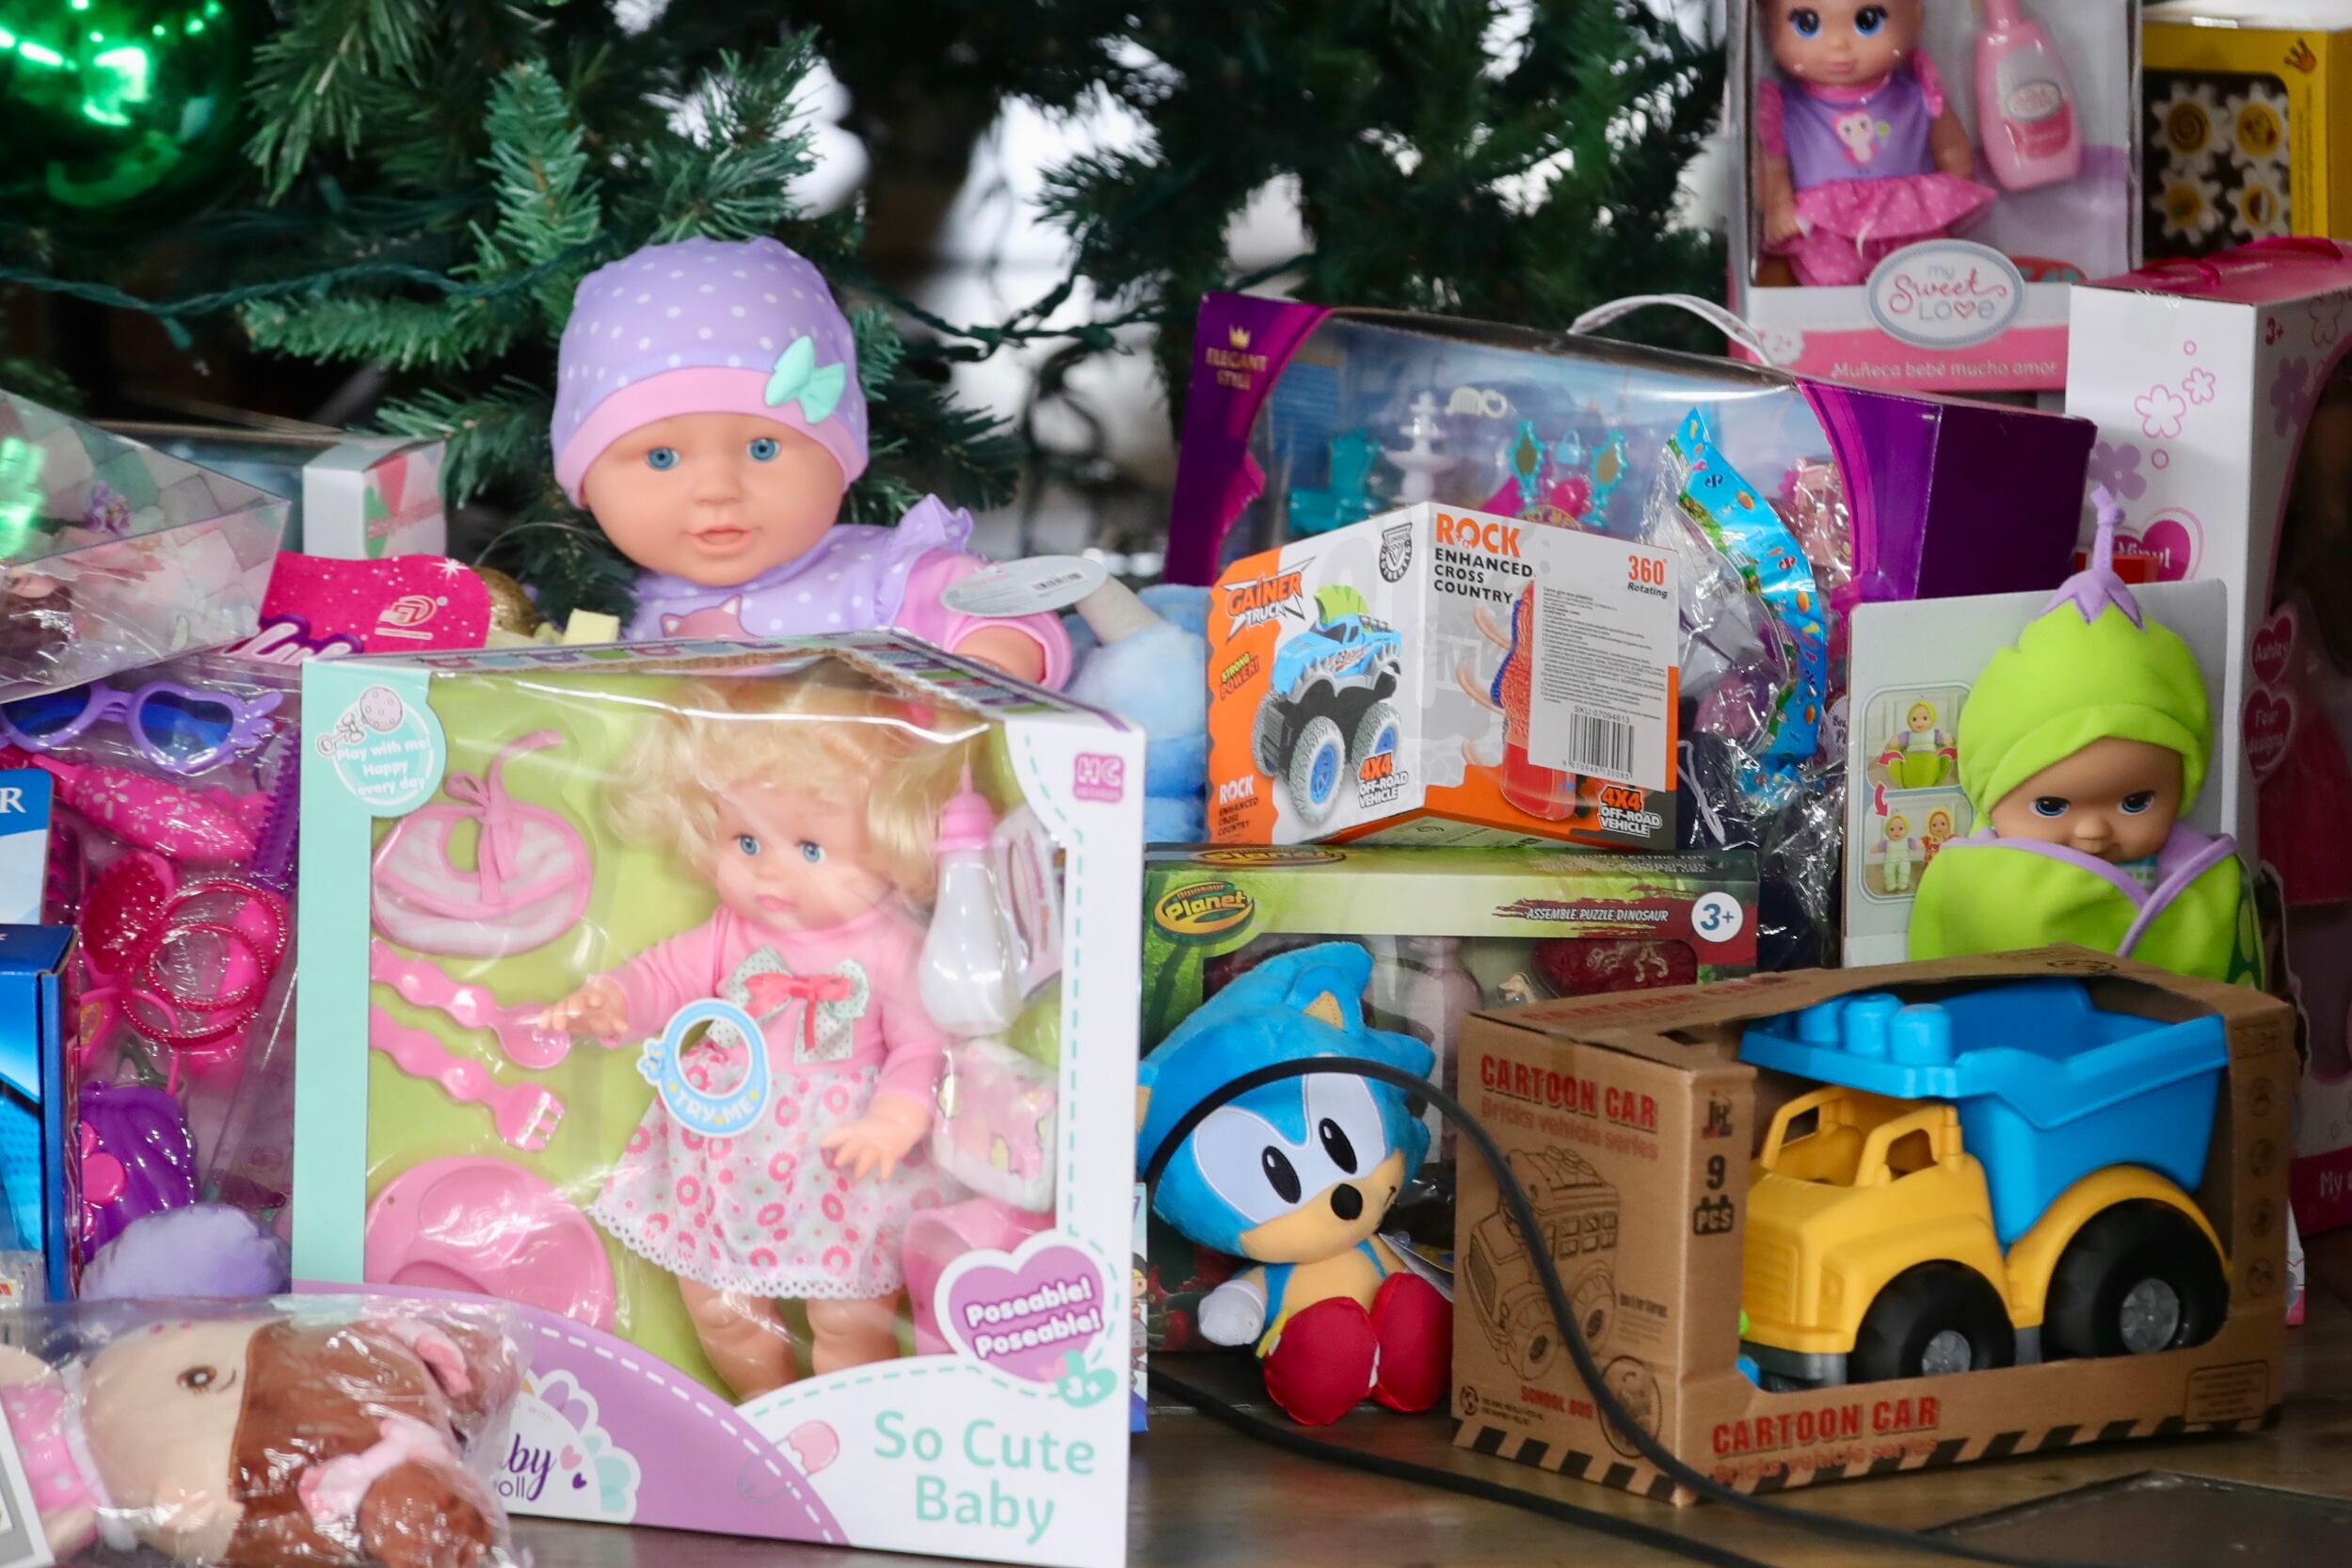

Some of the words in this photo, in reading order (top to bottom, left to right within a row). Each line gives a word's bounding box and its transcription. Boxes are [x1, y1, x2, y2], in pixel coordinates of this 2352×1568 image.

[1889, 267, 2008, 314] Sweet
[2265, 316, 2283, 346] 3+
[1832, 360, 1901, 378] Muñeca
[1905, 359, 1945, 377] bebé
[1950, 359, 2009, 377] mucho
[2012, 359, 2057, 376] amor
[1436, 513, 1522, 558] ROCK
[1434, 548, 1534, 578] ENHANCED
[1434, 564, 1485, 584] CROSS
[1226, 571, 1304, 616] GAINER
[1433, 579, 1513, 605] COUNTRY
[1627, 582, 1669, 600] Rotating
[1246, 602, 1288, 627] TRUCK
[1220, 651, 1252, 684] STRONG
[369, 739, 402, 757] with
[361, 760, 408, 776] Happy
[399, 774, 425, 792] day
[1077, 757, 1122, 787] HC
[1219, 775, 1256, 805] ROCK
[1358, 771, 1409, 798] OFF-ROAD
[1358, 789, 1400, 809] VEHICLE
[1601, 786, 1642, 810] 4X4
[1600, 806, 1663, 828] OFF-ROAD
[1600, 816, 1651, 836] VEHICLE
[1165, 890, 1248, 920] Planet
[1527, 908, 1577, 921] ASSEMBLE
[1579, 908, 1613, 921] PUZZLE
[1615, 909, 1670, 922] DINOSAUR
[1700, 902, 1736, 932] 3+
[675, 1090, 716, 1122] TRY
[722, 1096, 755, 1124] ME
[1480, 1054, 1599, 1117] CARTOON
[1605, 1086, 1658, 1132] CAR
[1480, 1097, 1534, 1132] Bricks
[1540, 1112, 1601, 1148] vehicle
[1605, 1133, 1658, 1160] series
[1706, 1154, 1727, 1191] 9
[2320, 1171, 2343, 1202] My
[1696, 1207, 1732, 1235] PCS
[965, 1275, 1095, 1329] Poseable!
[973, 1307, 1103, 1360] Poseable!
[1066, 1376, 1101, 1400] 3+
[1712, 1403, 1862, 1456] CARTOON
[1871, 1396, 1940, 1432] CAR
[874, 1409, 942, 1463] So
[963, 1418, 1096, 1476] Cute
[1714, 1459, 1784, 1484] Bricks
[495, 1476, 525, 1499] oll
[916, 1475, 1056, 1546] Baby
